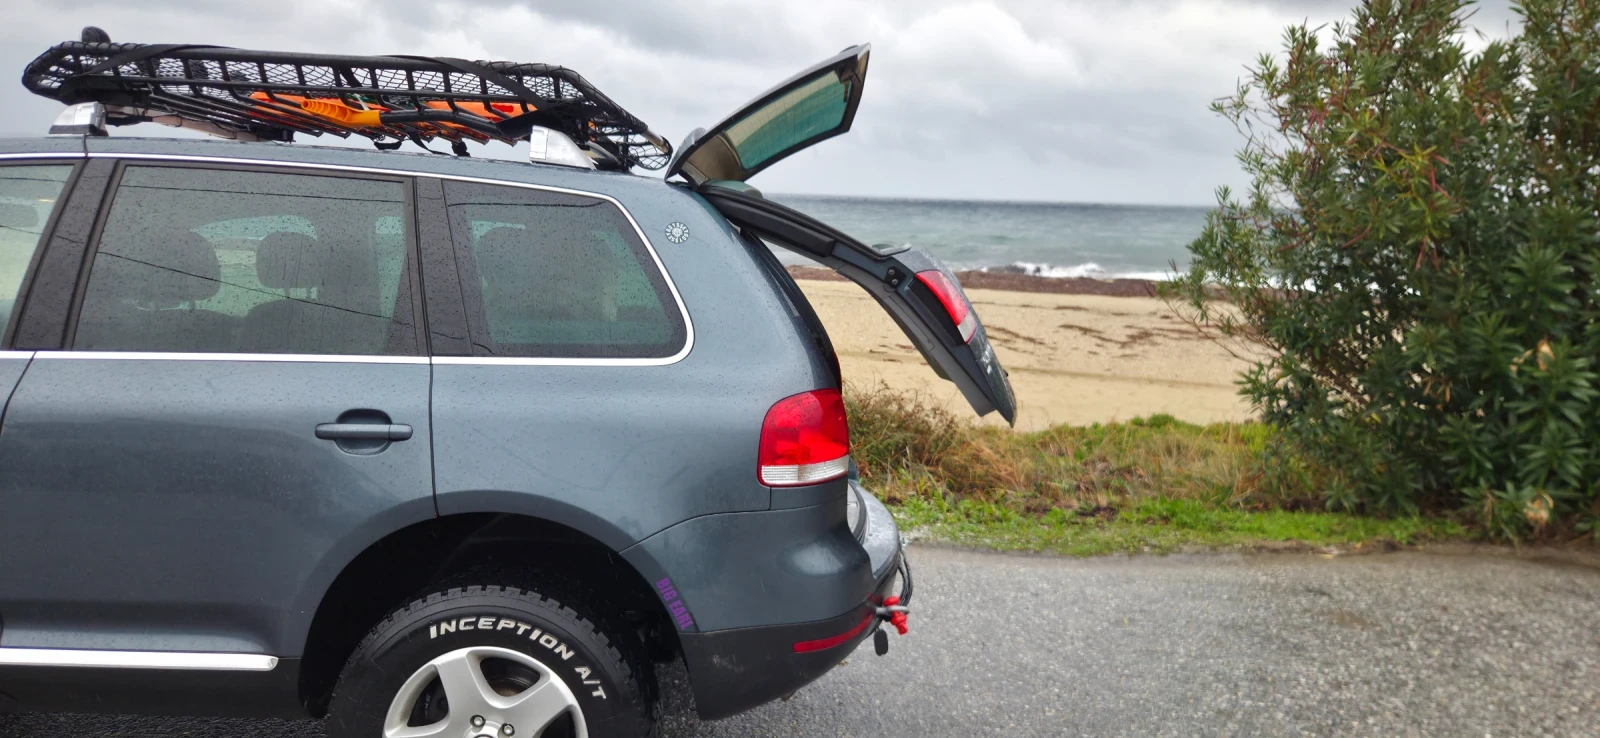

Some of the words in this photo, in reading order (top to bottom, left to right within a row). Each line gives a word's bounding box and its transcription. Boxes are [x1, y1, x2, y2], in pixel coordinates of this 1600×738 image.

[656, 577, 677, 601] BIG
[669, 600, 693, 630] EARL
[429, 616, 575, 660] INCEPTION
[574, 666, 607, 700] A/T
